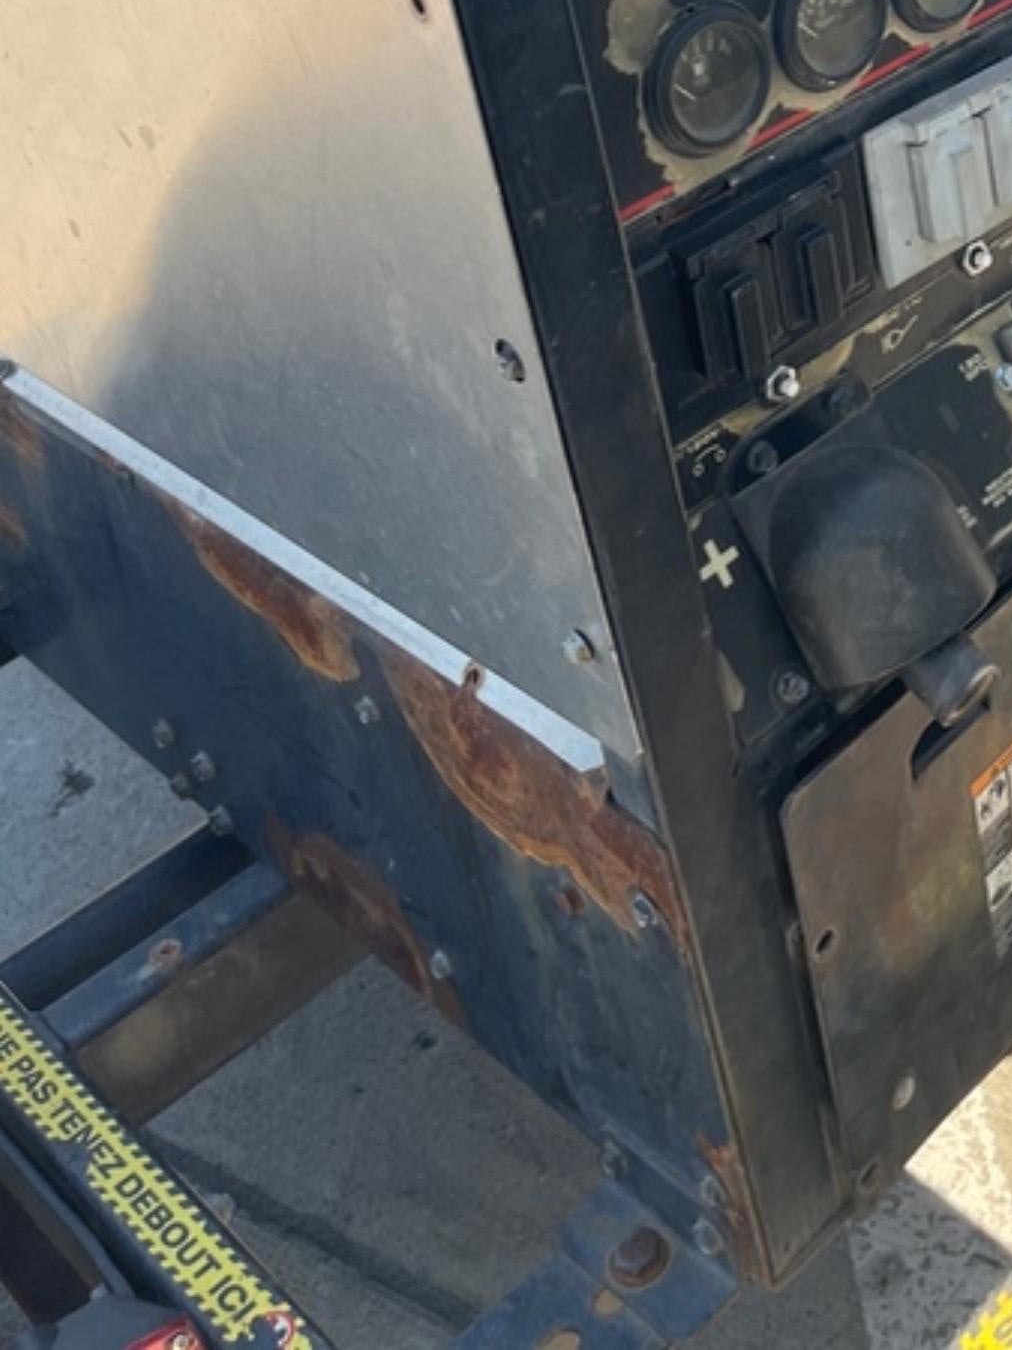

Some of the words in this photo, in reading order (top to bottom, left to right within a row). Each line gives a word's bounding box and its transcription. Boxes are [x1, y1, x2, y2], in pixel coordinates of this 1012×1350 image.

[8, 1052, 59, 1106] PAS
[51, 1096, 128, 1181] TENEZ
[115, 1172, 223, 1279] DEBOUT
[208, 1274, 259, 1322] ICI
